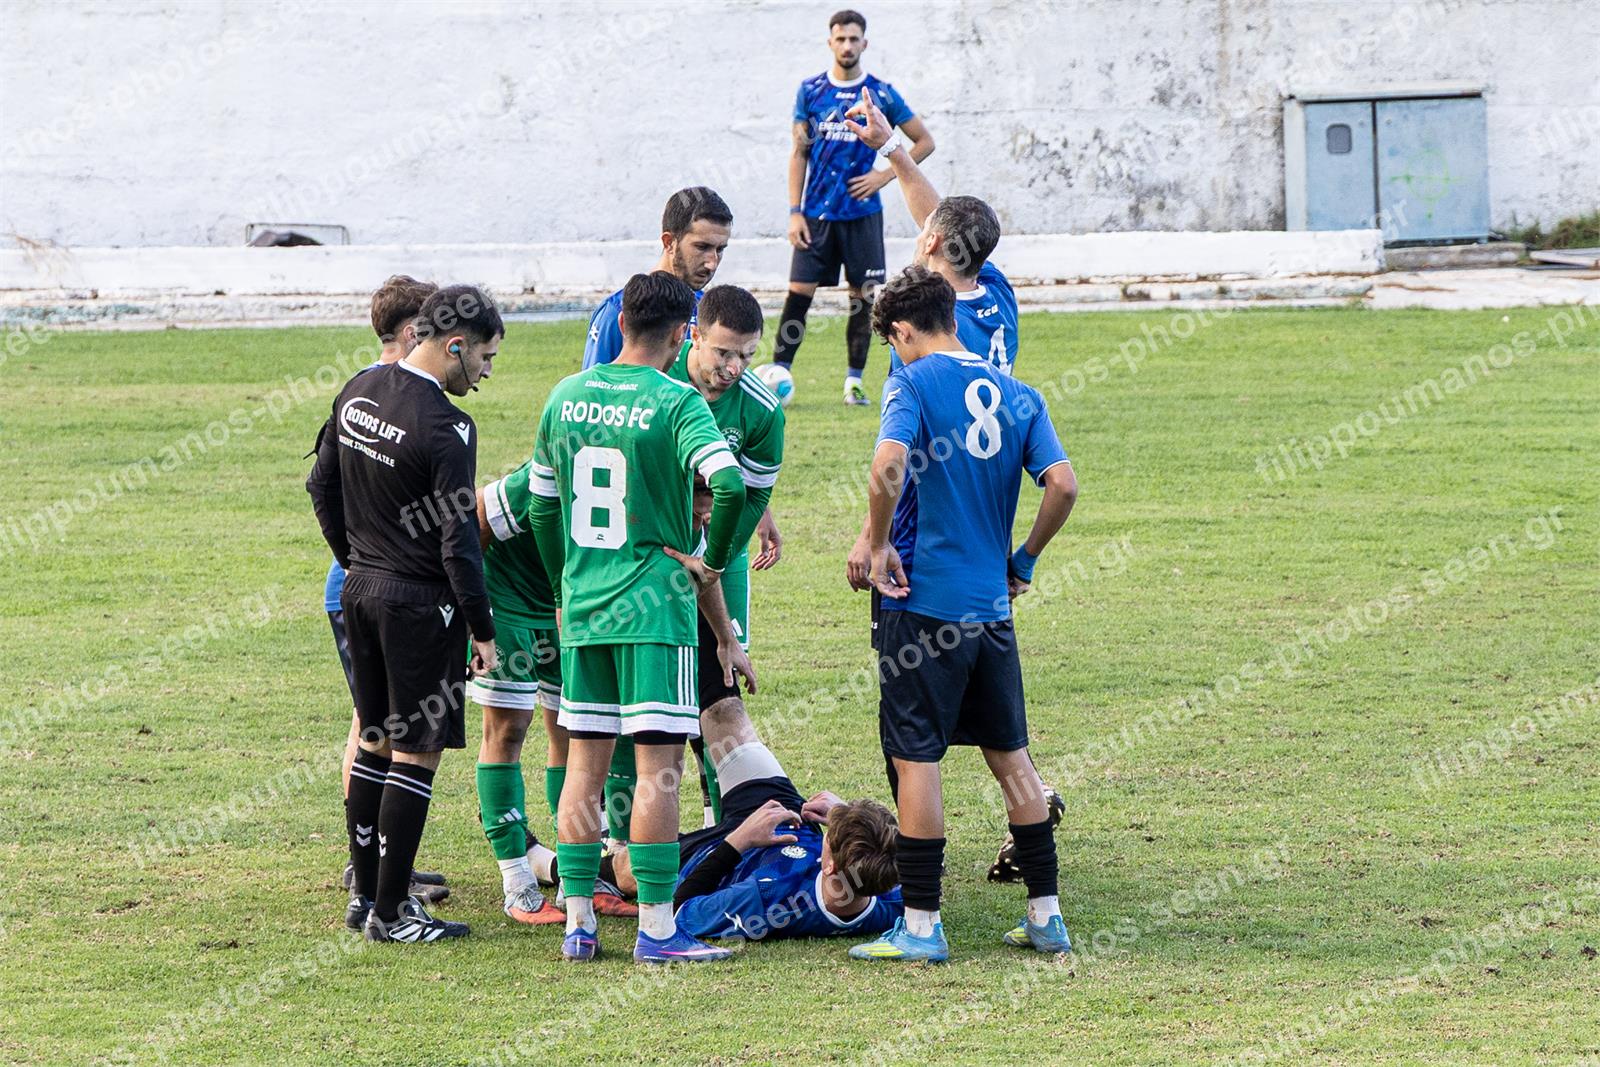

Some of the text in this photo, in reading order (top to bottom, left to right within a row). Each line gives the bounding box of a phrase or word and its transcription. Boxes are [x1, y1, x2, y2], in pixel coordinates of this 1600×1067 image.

[346, 406, 380, 434] RODOS
[378, 420, 407, 444] LIFT
[560, 401, 654, 430] RODOS FC
[964, 378, 1002, 460] 8
[570, 445, 627, 550] 8
